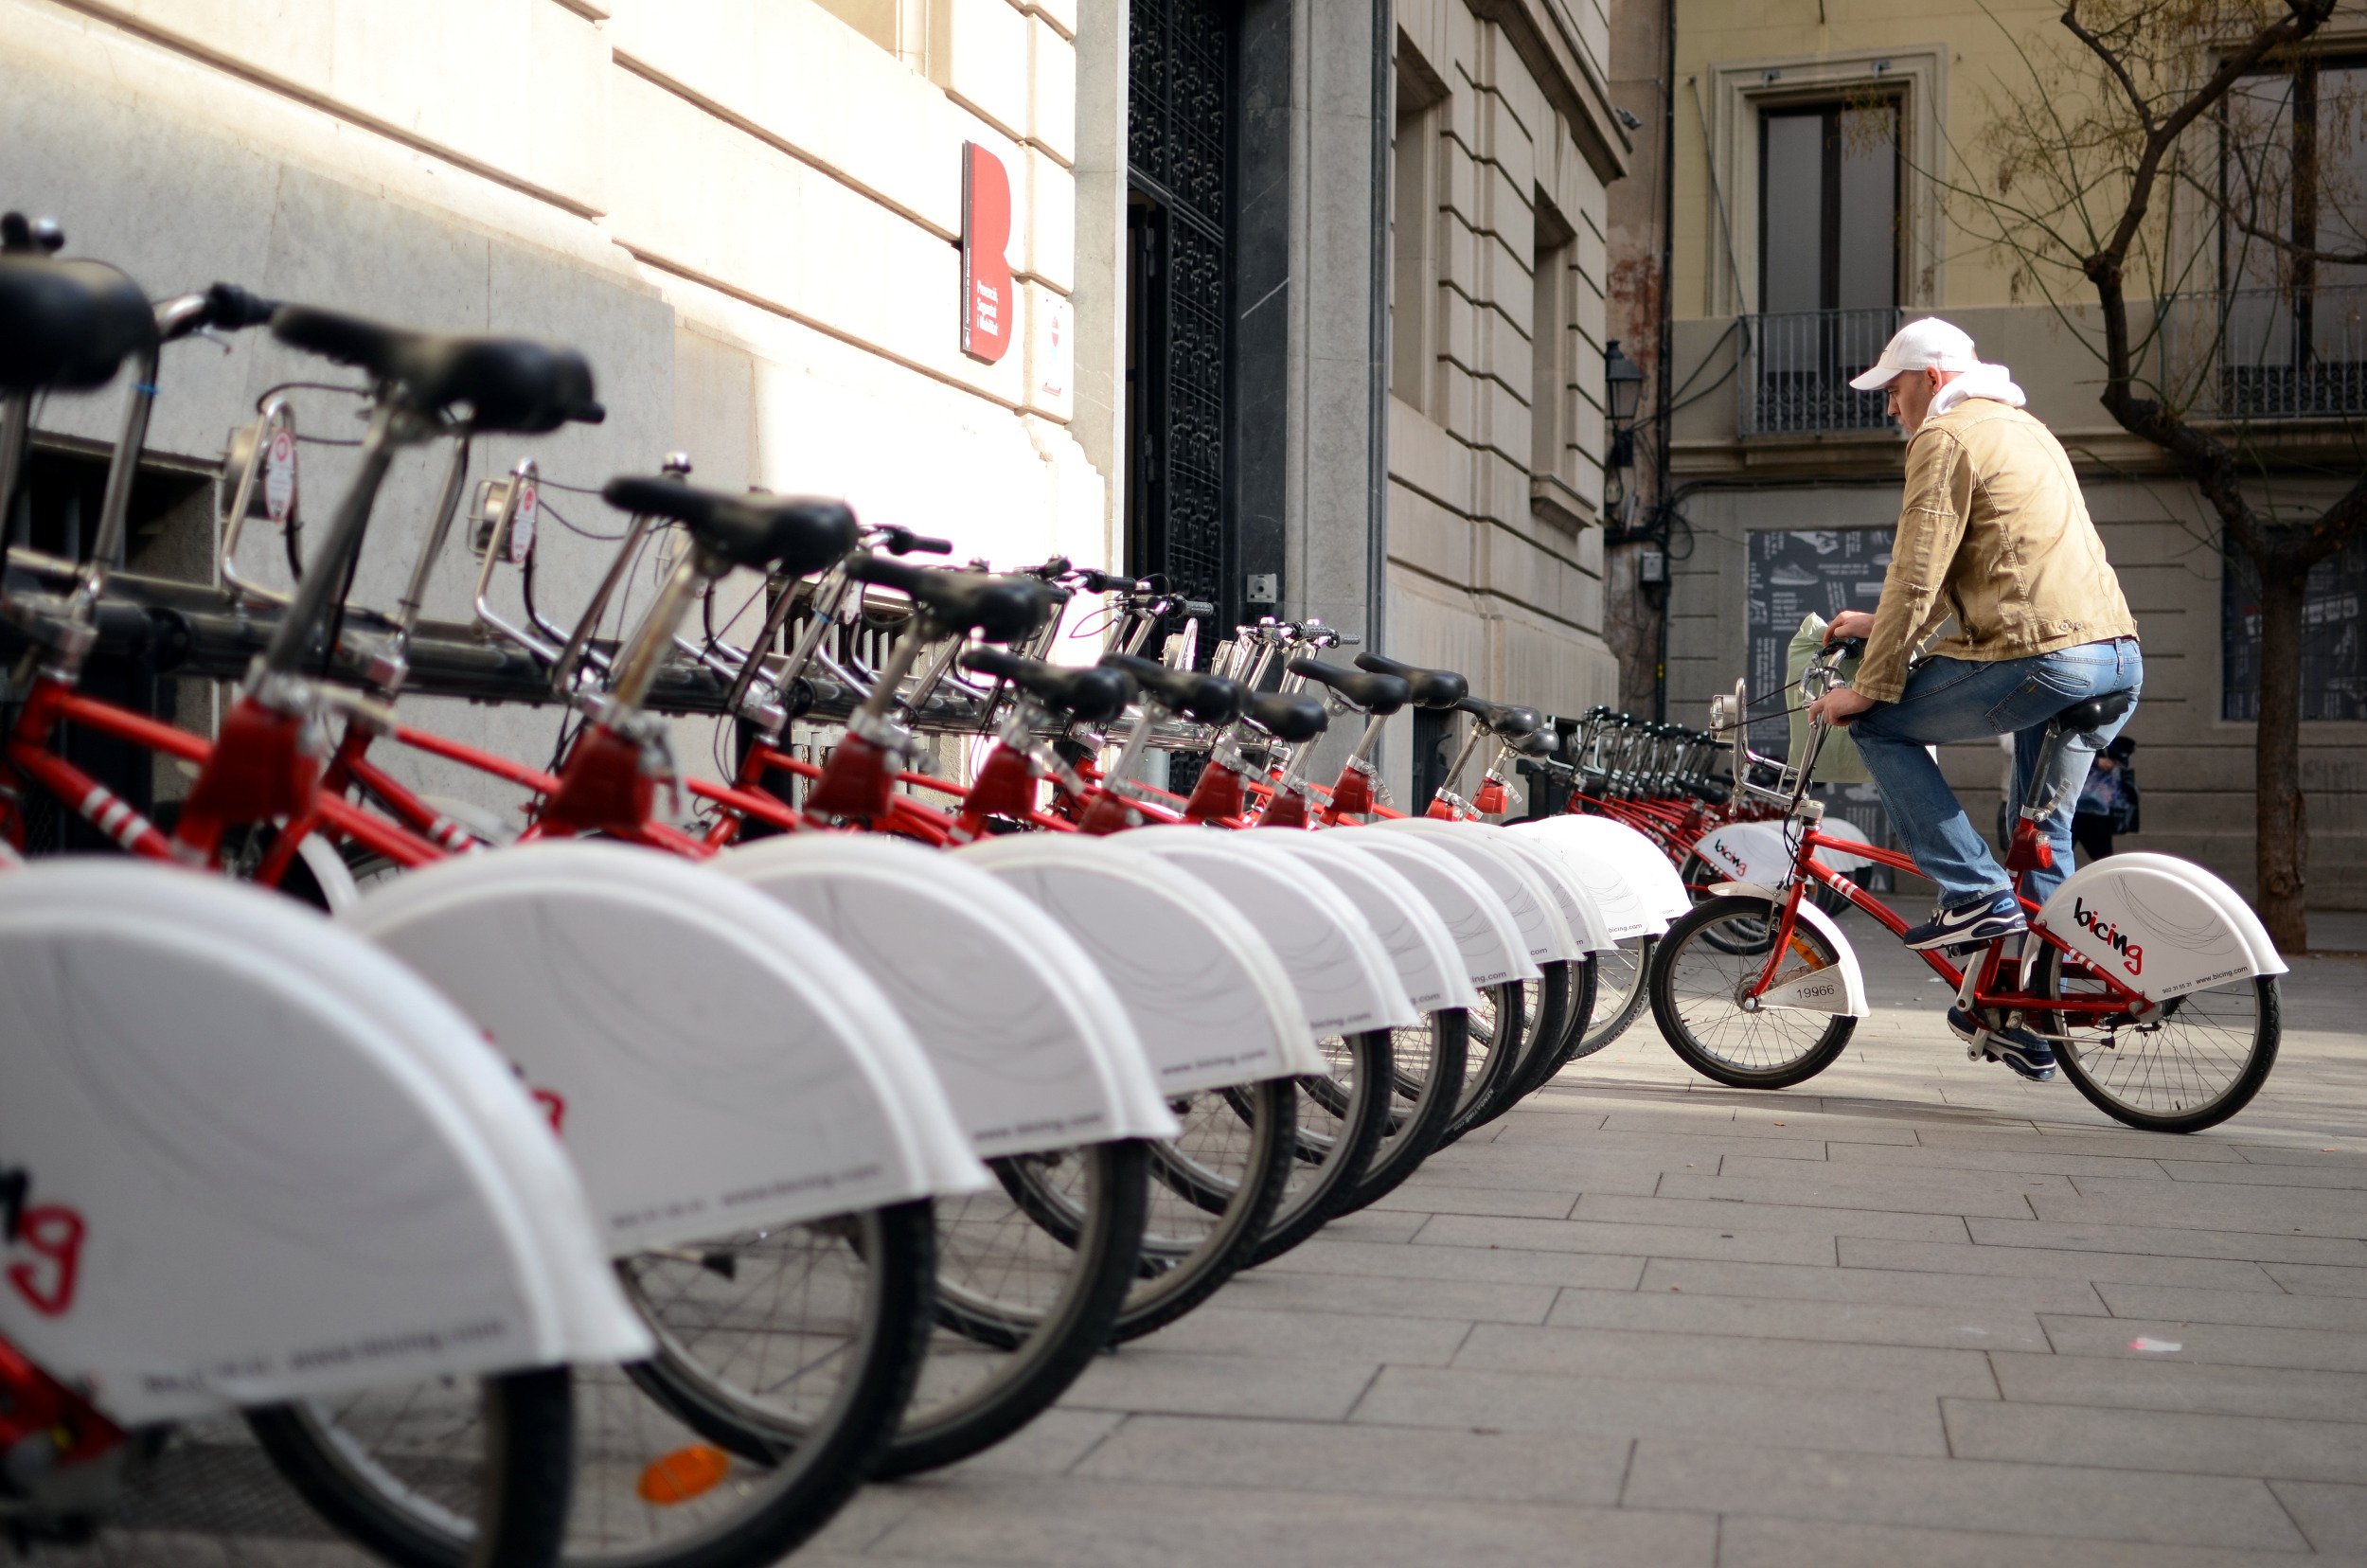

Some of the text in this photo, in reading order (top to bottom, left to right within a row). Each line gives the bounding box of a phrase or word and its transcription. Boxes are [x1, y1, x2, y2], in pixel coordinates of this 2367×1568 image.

[1715, 839, 1747, 877] bicing
[2073, 897, 2143, 976] bicing
[2196, 966, 2249, 985] www.bicing.com
[1797, 985, 1835, 999] 19966
